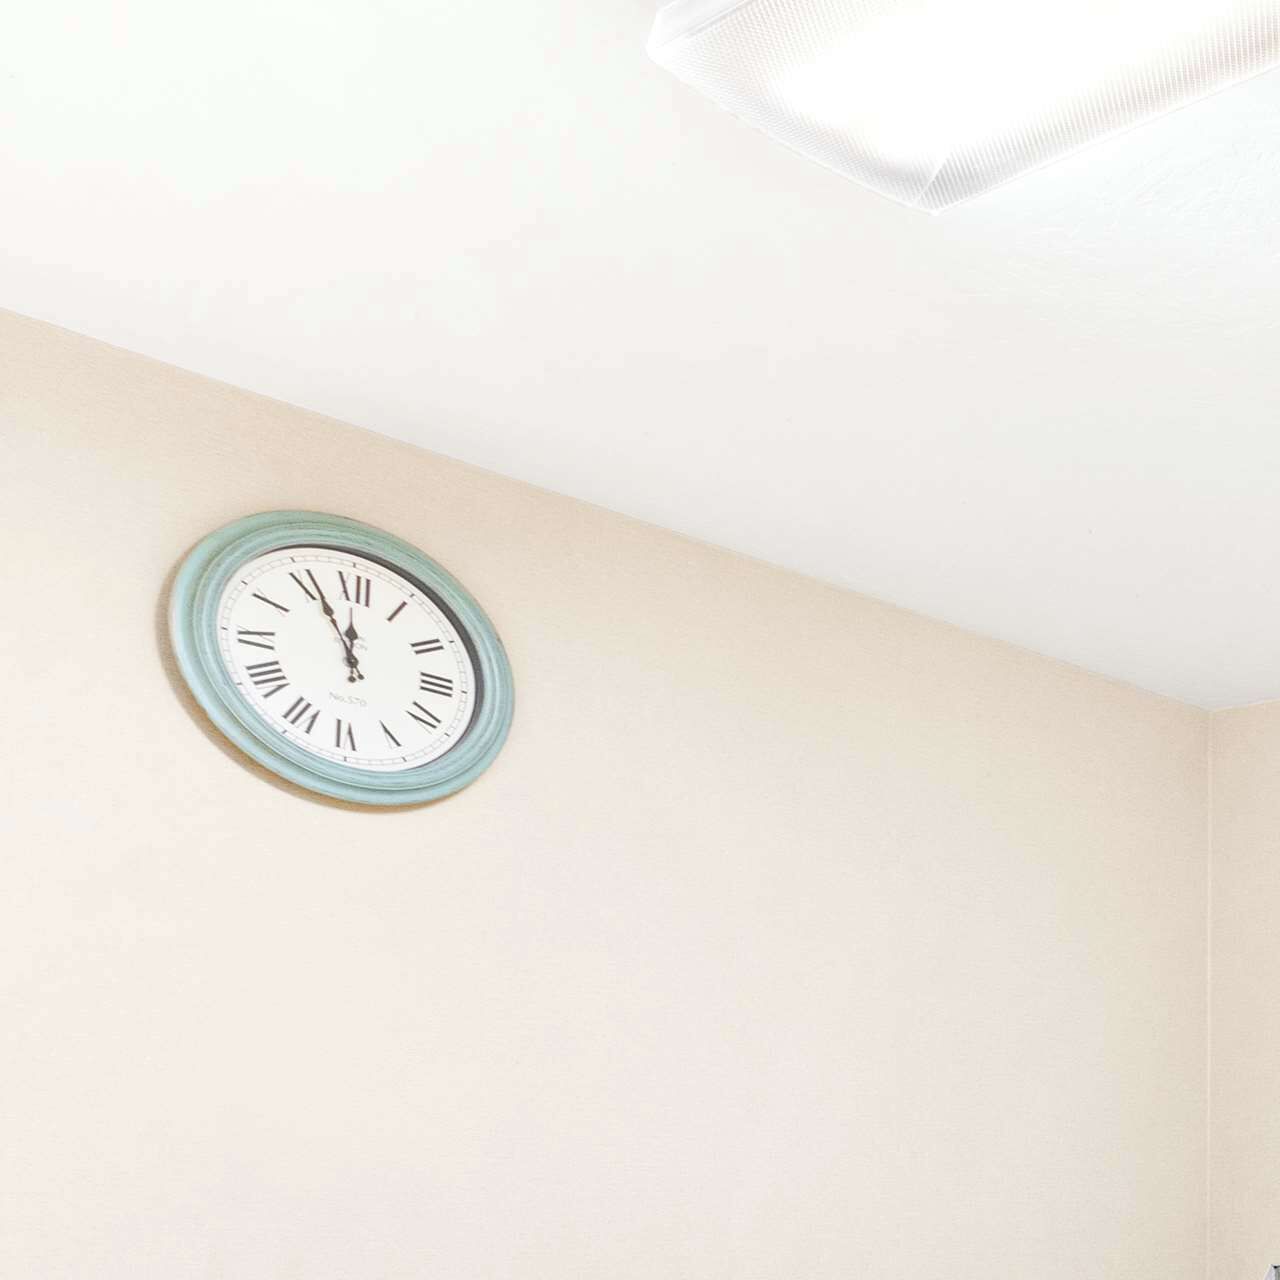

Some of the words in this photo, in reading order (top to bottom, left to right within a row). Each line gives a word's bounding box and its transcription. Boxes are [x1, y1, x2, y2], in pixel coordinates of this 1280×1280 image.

[338, 570, 371, 607] XII
[387, 601, 408, 622] I
[236, 626, 277, 651] IX
[410, 638, 446, 655] II
[245, 660, 291, 699] VIII
[418, 671, 454, 698] III
[282, 696, 322, 735] VII
[406, 701, 442, 734] IV
[335, 717, 358, 752] VI
[379, 720, 402, 749] V
